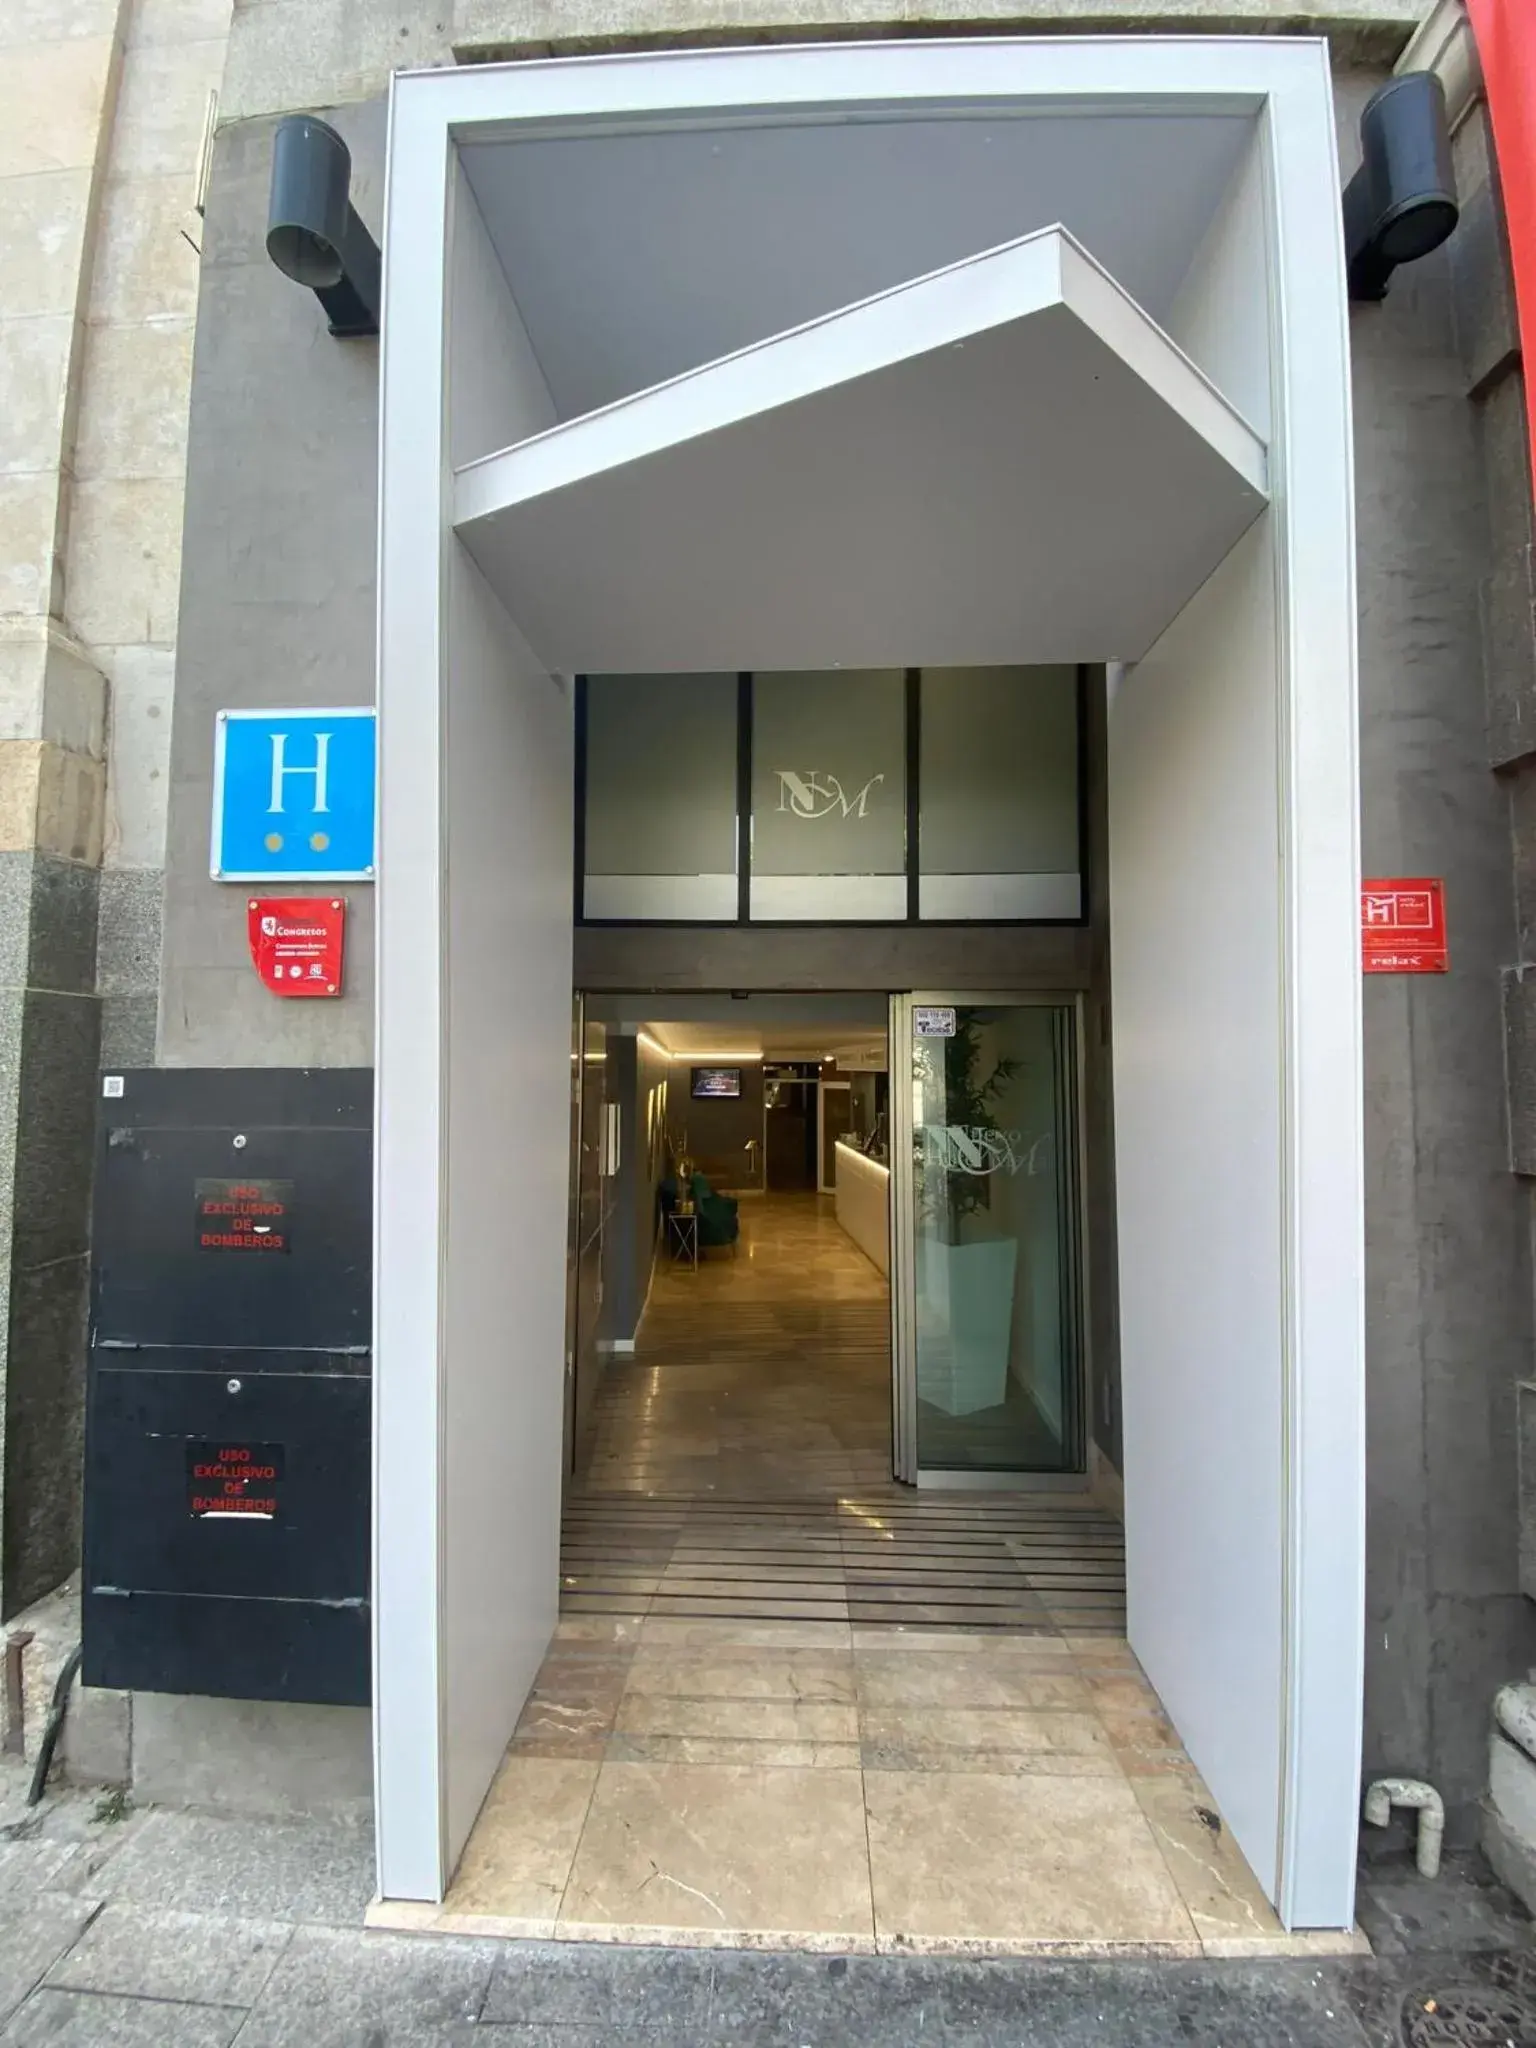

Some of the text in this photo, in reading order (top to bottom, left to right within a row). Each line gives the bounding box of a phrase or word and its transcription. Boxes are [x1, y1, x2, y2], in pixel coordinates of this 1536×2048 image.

[266, 732, 335, 813] H
[228, 1185, 261, 1199] USO
[203, 1202, 284, 1215] EXCLUSIVO
[232, 1218, 252, 1232] DE
[200, 1234, 284, 1248] BOMBEROS
[219, 1449, 251, 1461] USO
[193, 1465, 276, 1479] EXCLUSIVO
[224, 1482, 245, 1495] DE
[192, 1497, 277, 1511] BOMBEROS
